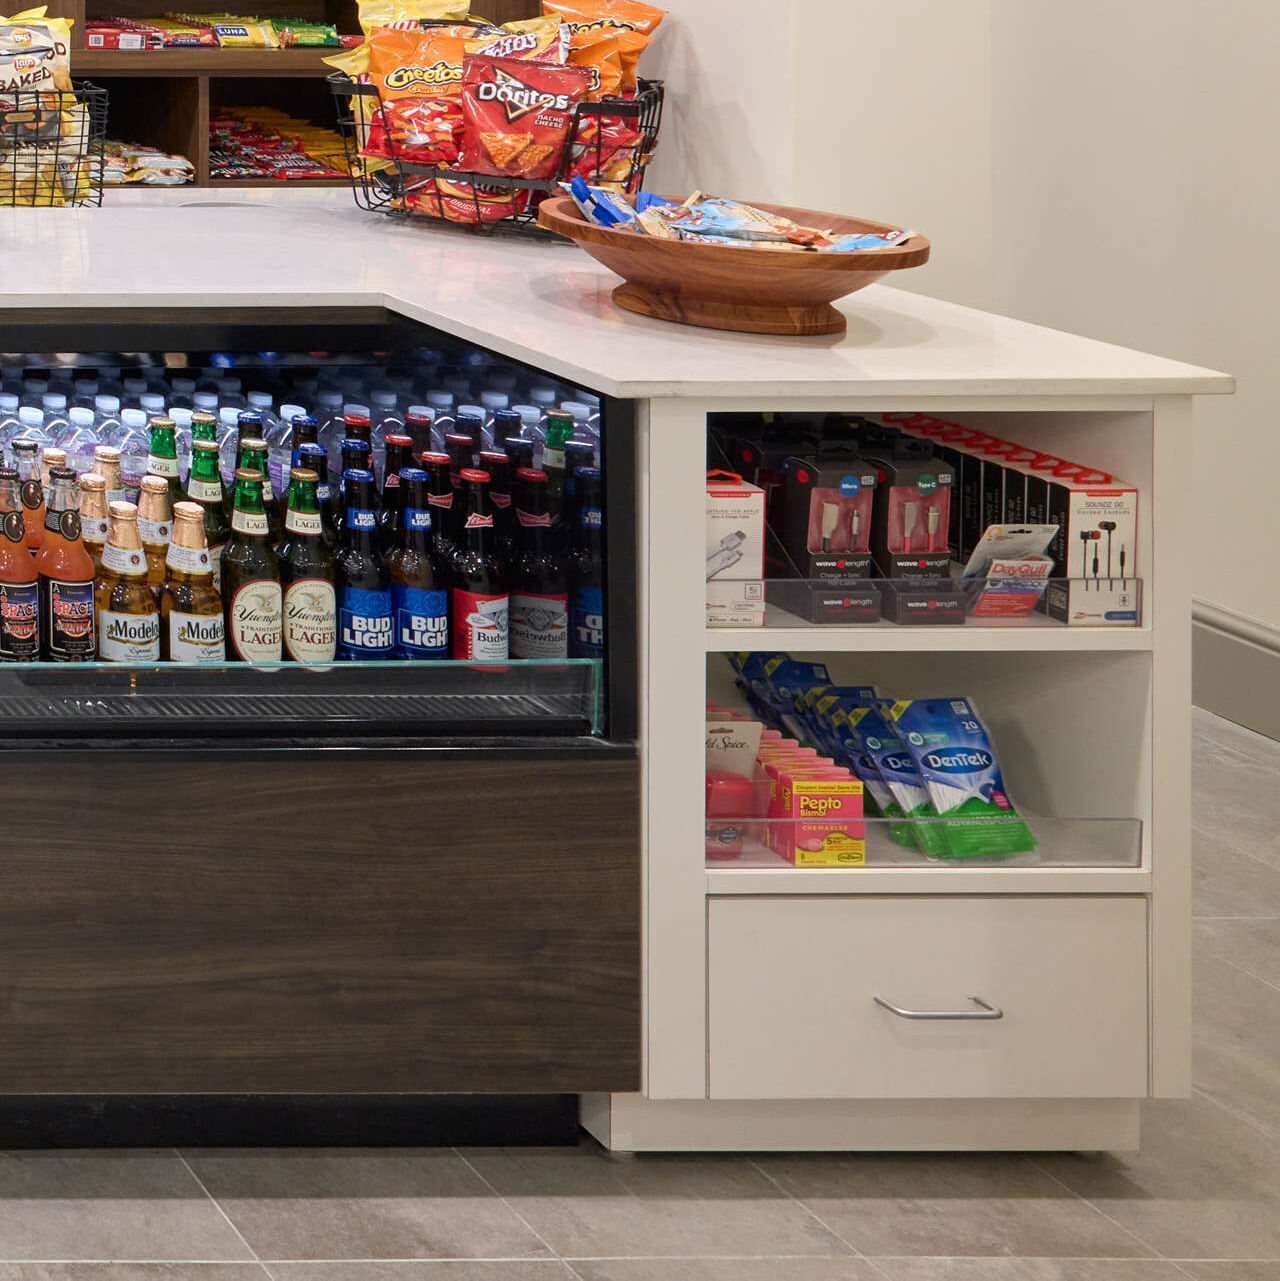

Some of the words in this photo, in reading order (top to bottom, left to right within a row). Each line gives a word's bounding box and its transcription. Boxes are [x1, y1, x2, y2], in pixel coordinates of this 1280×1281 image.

[479, 82, 569, 110] Doritos
[534, 120, 564, 128] CHEESE
[537, 114, 564, 123] NACHO
[992, 563, 1047, 576] DayQuil
[352, 615, 391, 632] BUD
[411, 615, 447, 631] BUD
[962, 721, 978, 730] 20
[717, 735, 746, 752] Spice
[928, 752, 989, 768] DenTek
[800, 796, 842, 813] Pepto
[800, 808, 826, 817] Bismol
